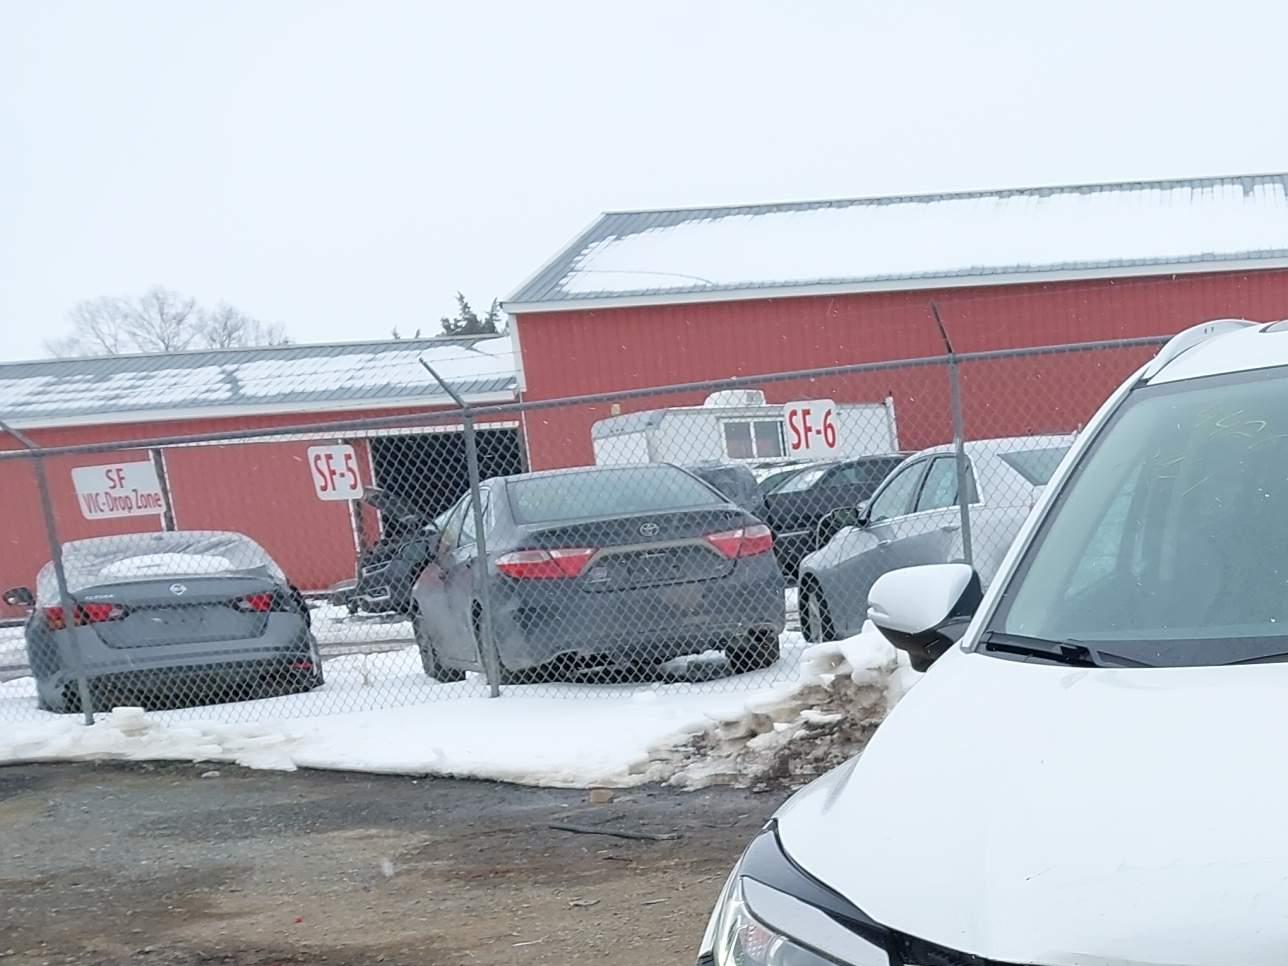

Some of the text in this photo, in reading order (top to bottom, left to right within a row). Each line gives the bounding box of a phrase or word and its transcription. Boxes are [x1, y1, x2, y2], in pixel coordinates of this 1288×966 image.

[788, 408, 837, 450] SF-6
[105, 468, 126, 490] SF
[313, 453, 358, 492] SF-5
[82, 488, 162, 514] VIC-Drop Zone
